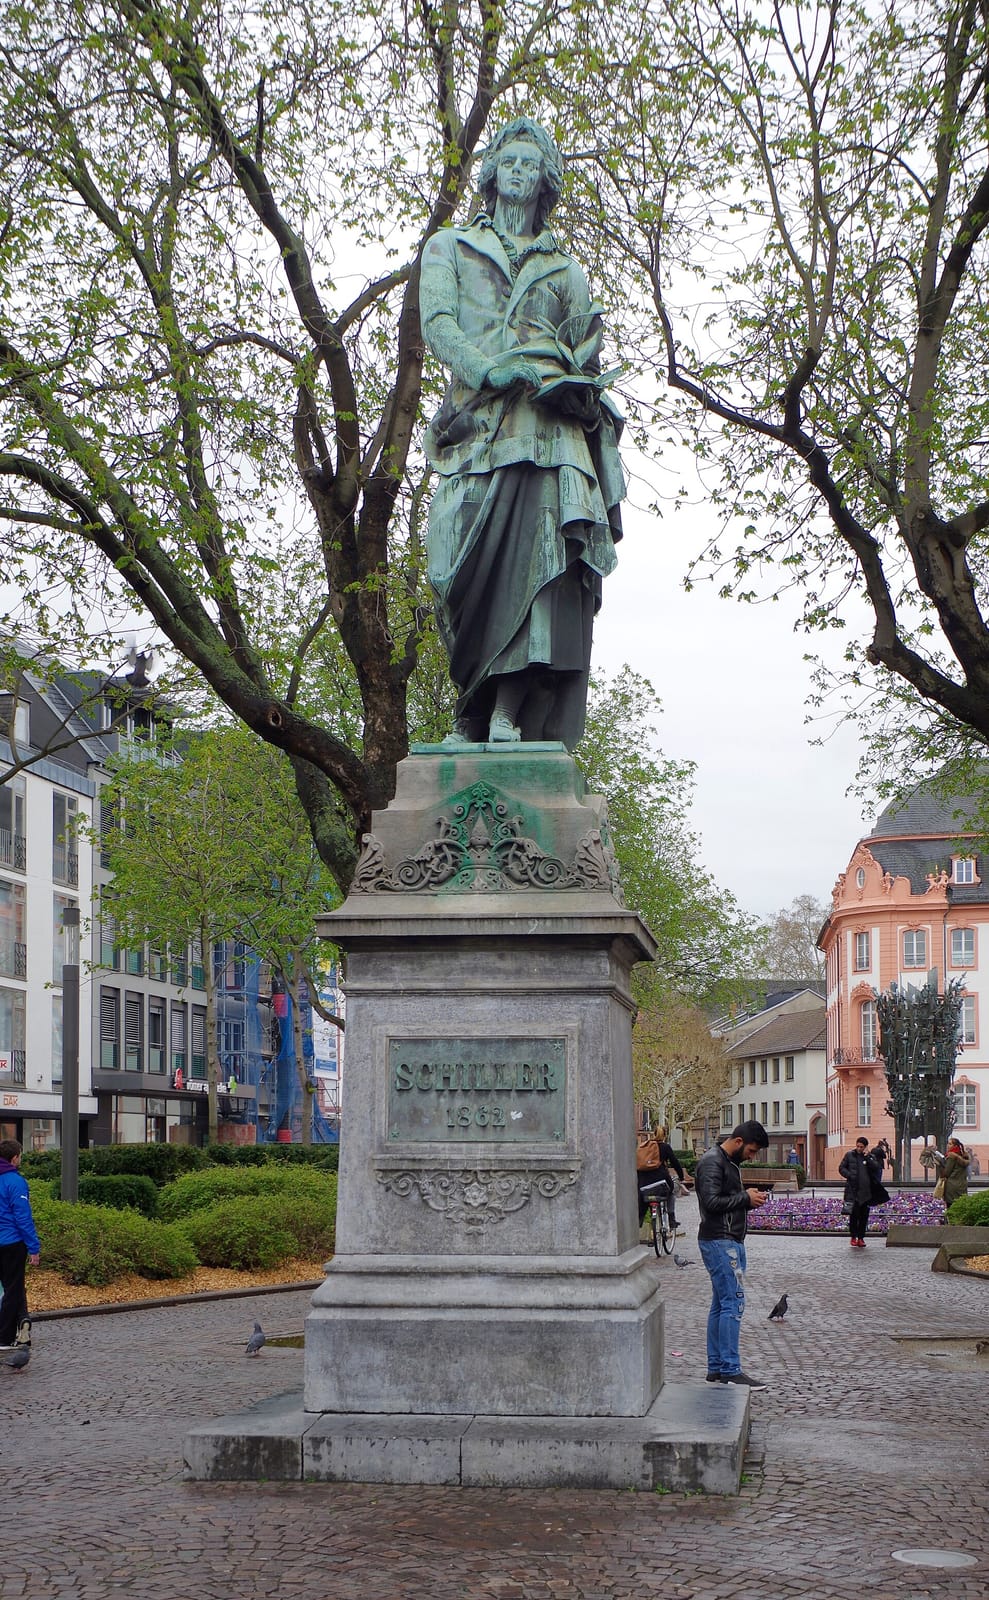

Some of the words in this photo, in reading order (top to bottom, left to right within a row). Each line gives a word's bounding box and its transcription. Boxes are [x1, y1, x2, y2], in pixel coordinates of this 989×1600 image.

[396, 1063, 557, 1091] SCHILLER
[3, 1096, 18, 1106] DAK
[447, 1106, 505, 1128] 1862
